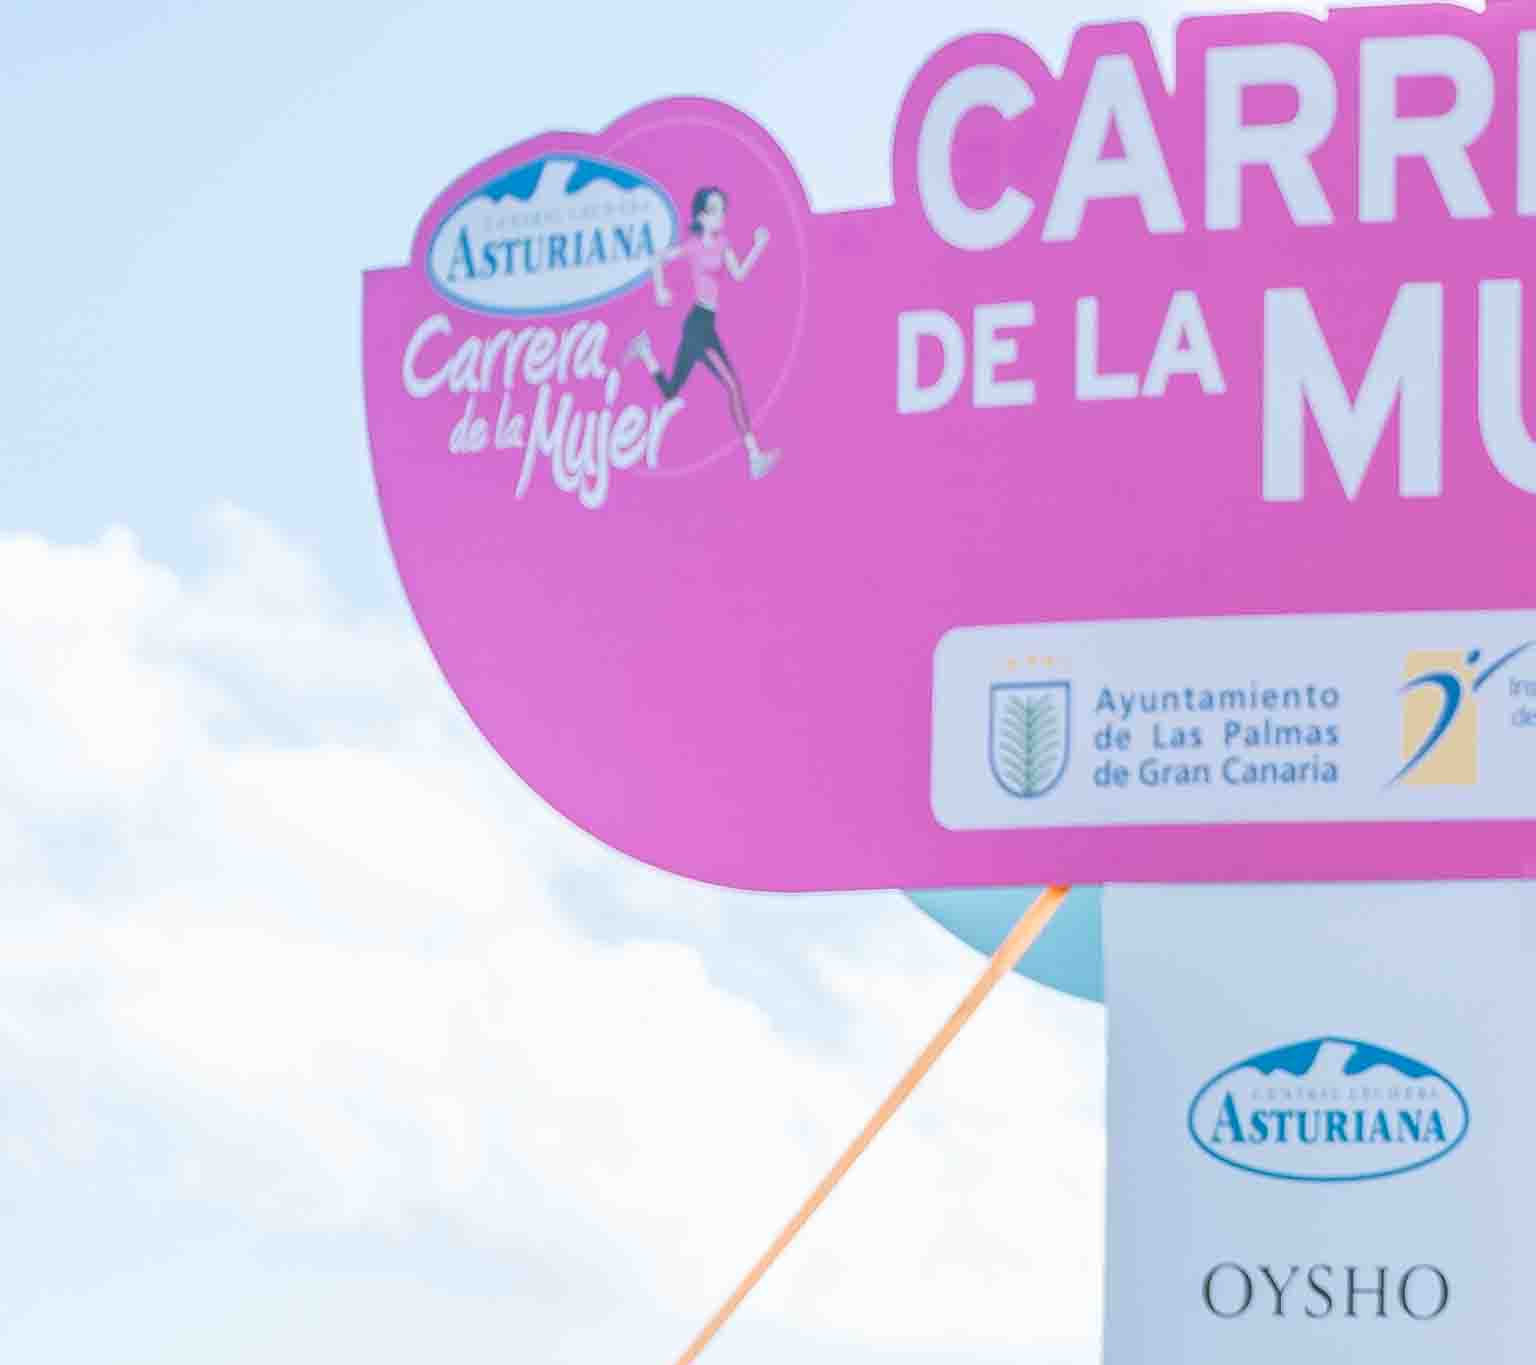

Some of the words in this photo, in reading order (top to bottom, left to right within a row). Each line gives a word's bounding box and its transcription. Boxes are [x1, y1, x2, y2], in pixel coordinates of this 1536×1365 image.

[446, 218, 656, 282] ASTURIANA
[404, 315, 607, 398] Carrera
[898, 303, 1036, 414] DE
[1075, 289, 1228, 400] LA
[448, 412, 487, 455] de
[494, 401, 524, 450] la
[515, 371, 688, 509] Mujer
[1094, 681, 1341, 719] Ayuntamiento
[1511, 704, 1536, 728] de
[1094, 720, 1133, 751] de
[1153, 719, 1202, 750] Las
[1225, 715, 1341, 748] Palmas
[1094, 758, 1132, 788] de
[1139, 758, 1210, 788] Gran
[1221, 753, 1341, 787] Canaria
[1210, 1092, 1448, 1145] ASTURIANA
[1202, 1262, 1450, 1322] OYSHO
